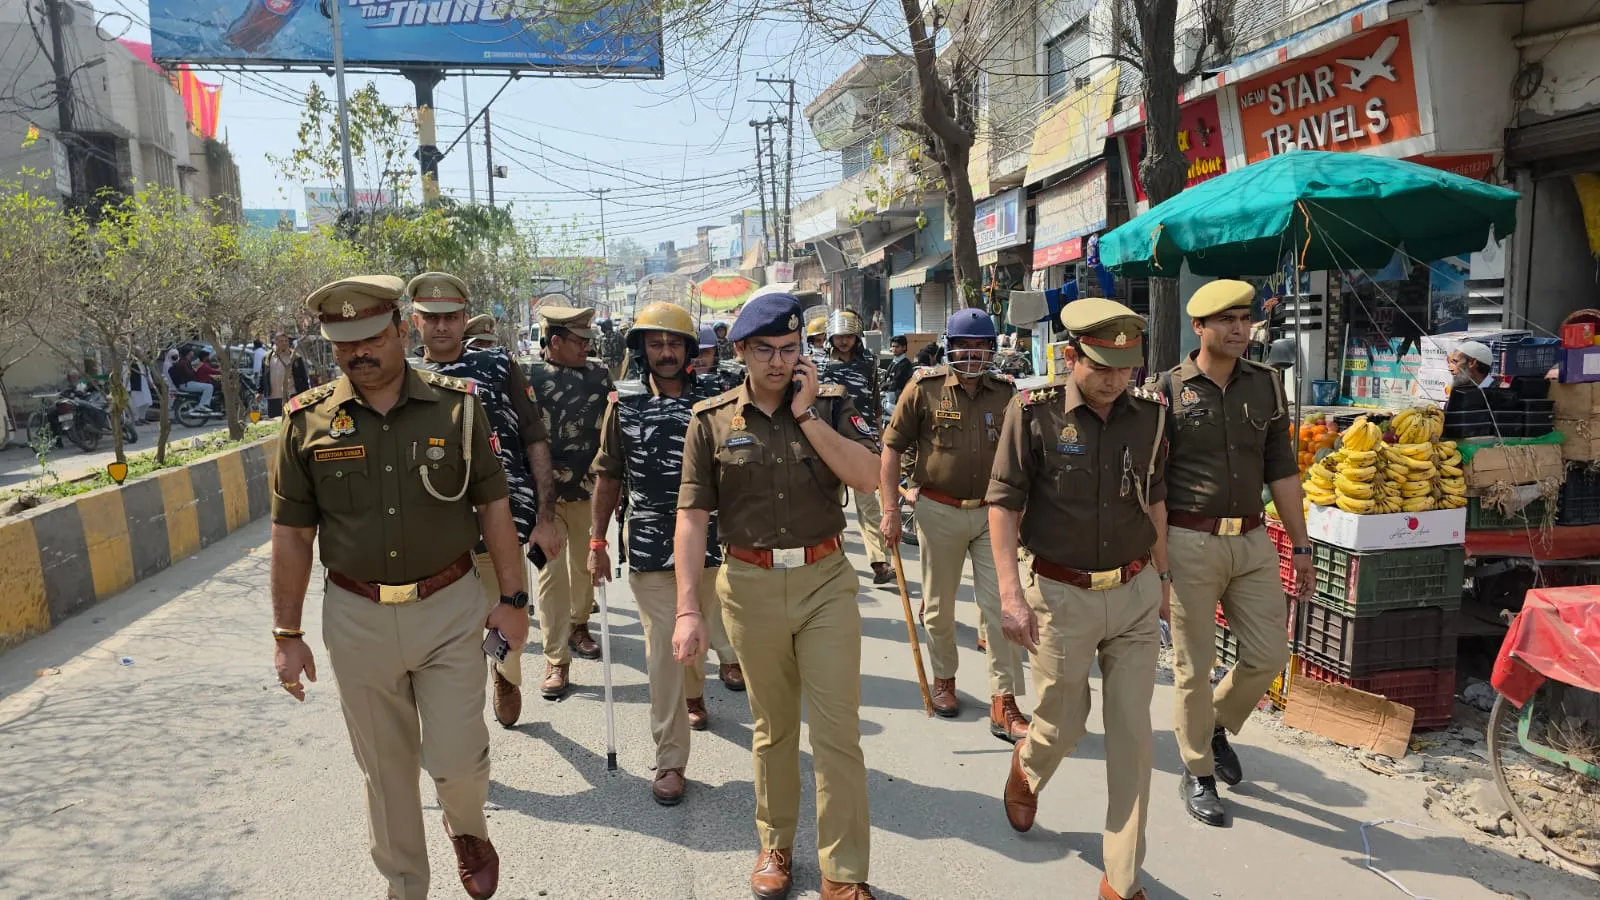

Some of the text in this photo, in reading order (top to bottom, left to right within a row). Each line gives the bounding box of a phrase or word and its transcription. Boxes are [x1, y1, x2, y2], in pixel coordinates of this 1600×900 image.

[1240, 65, 1336, 116] NEW STAR
[1261, 97, 1389, 158] TRAVELS
